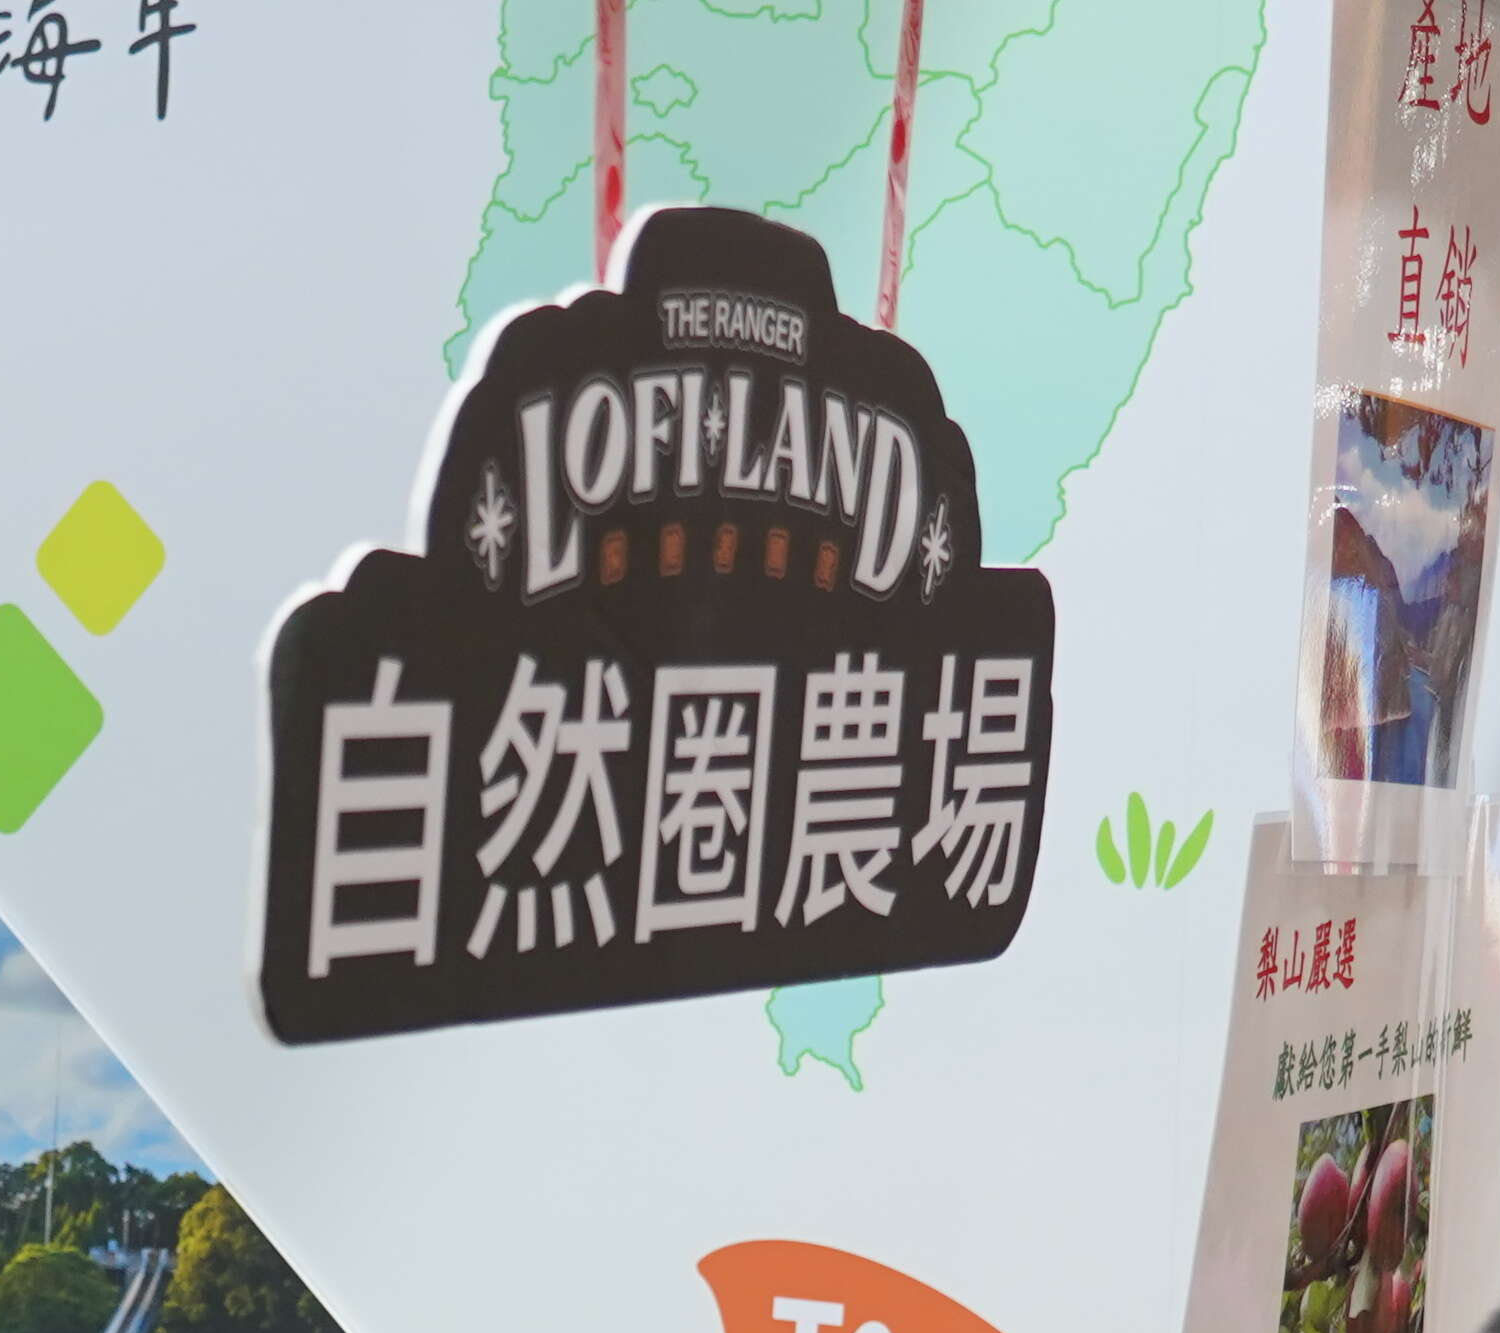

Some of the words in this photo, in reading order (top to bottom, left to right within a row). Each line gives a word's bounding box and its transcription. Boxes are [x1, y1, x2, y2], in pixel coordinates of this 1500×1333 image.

[662, 297, 709, 340] THE
[713, 300, 804, 355] RANGER
[1387, 205, 1477, 368] 直銷
[307, 653, 1034, 978] 自然圈農場
[1255, 919, 1358, 1003] 梨山嚴選
